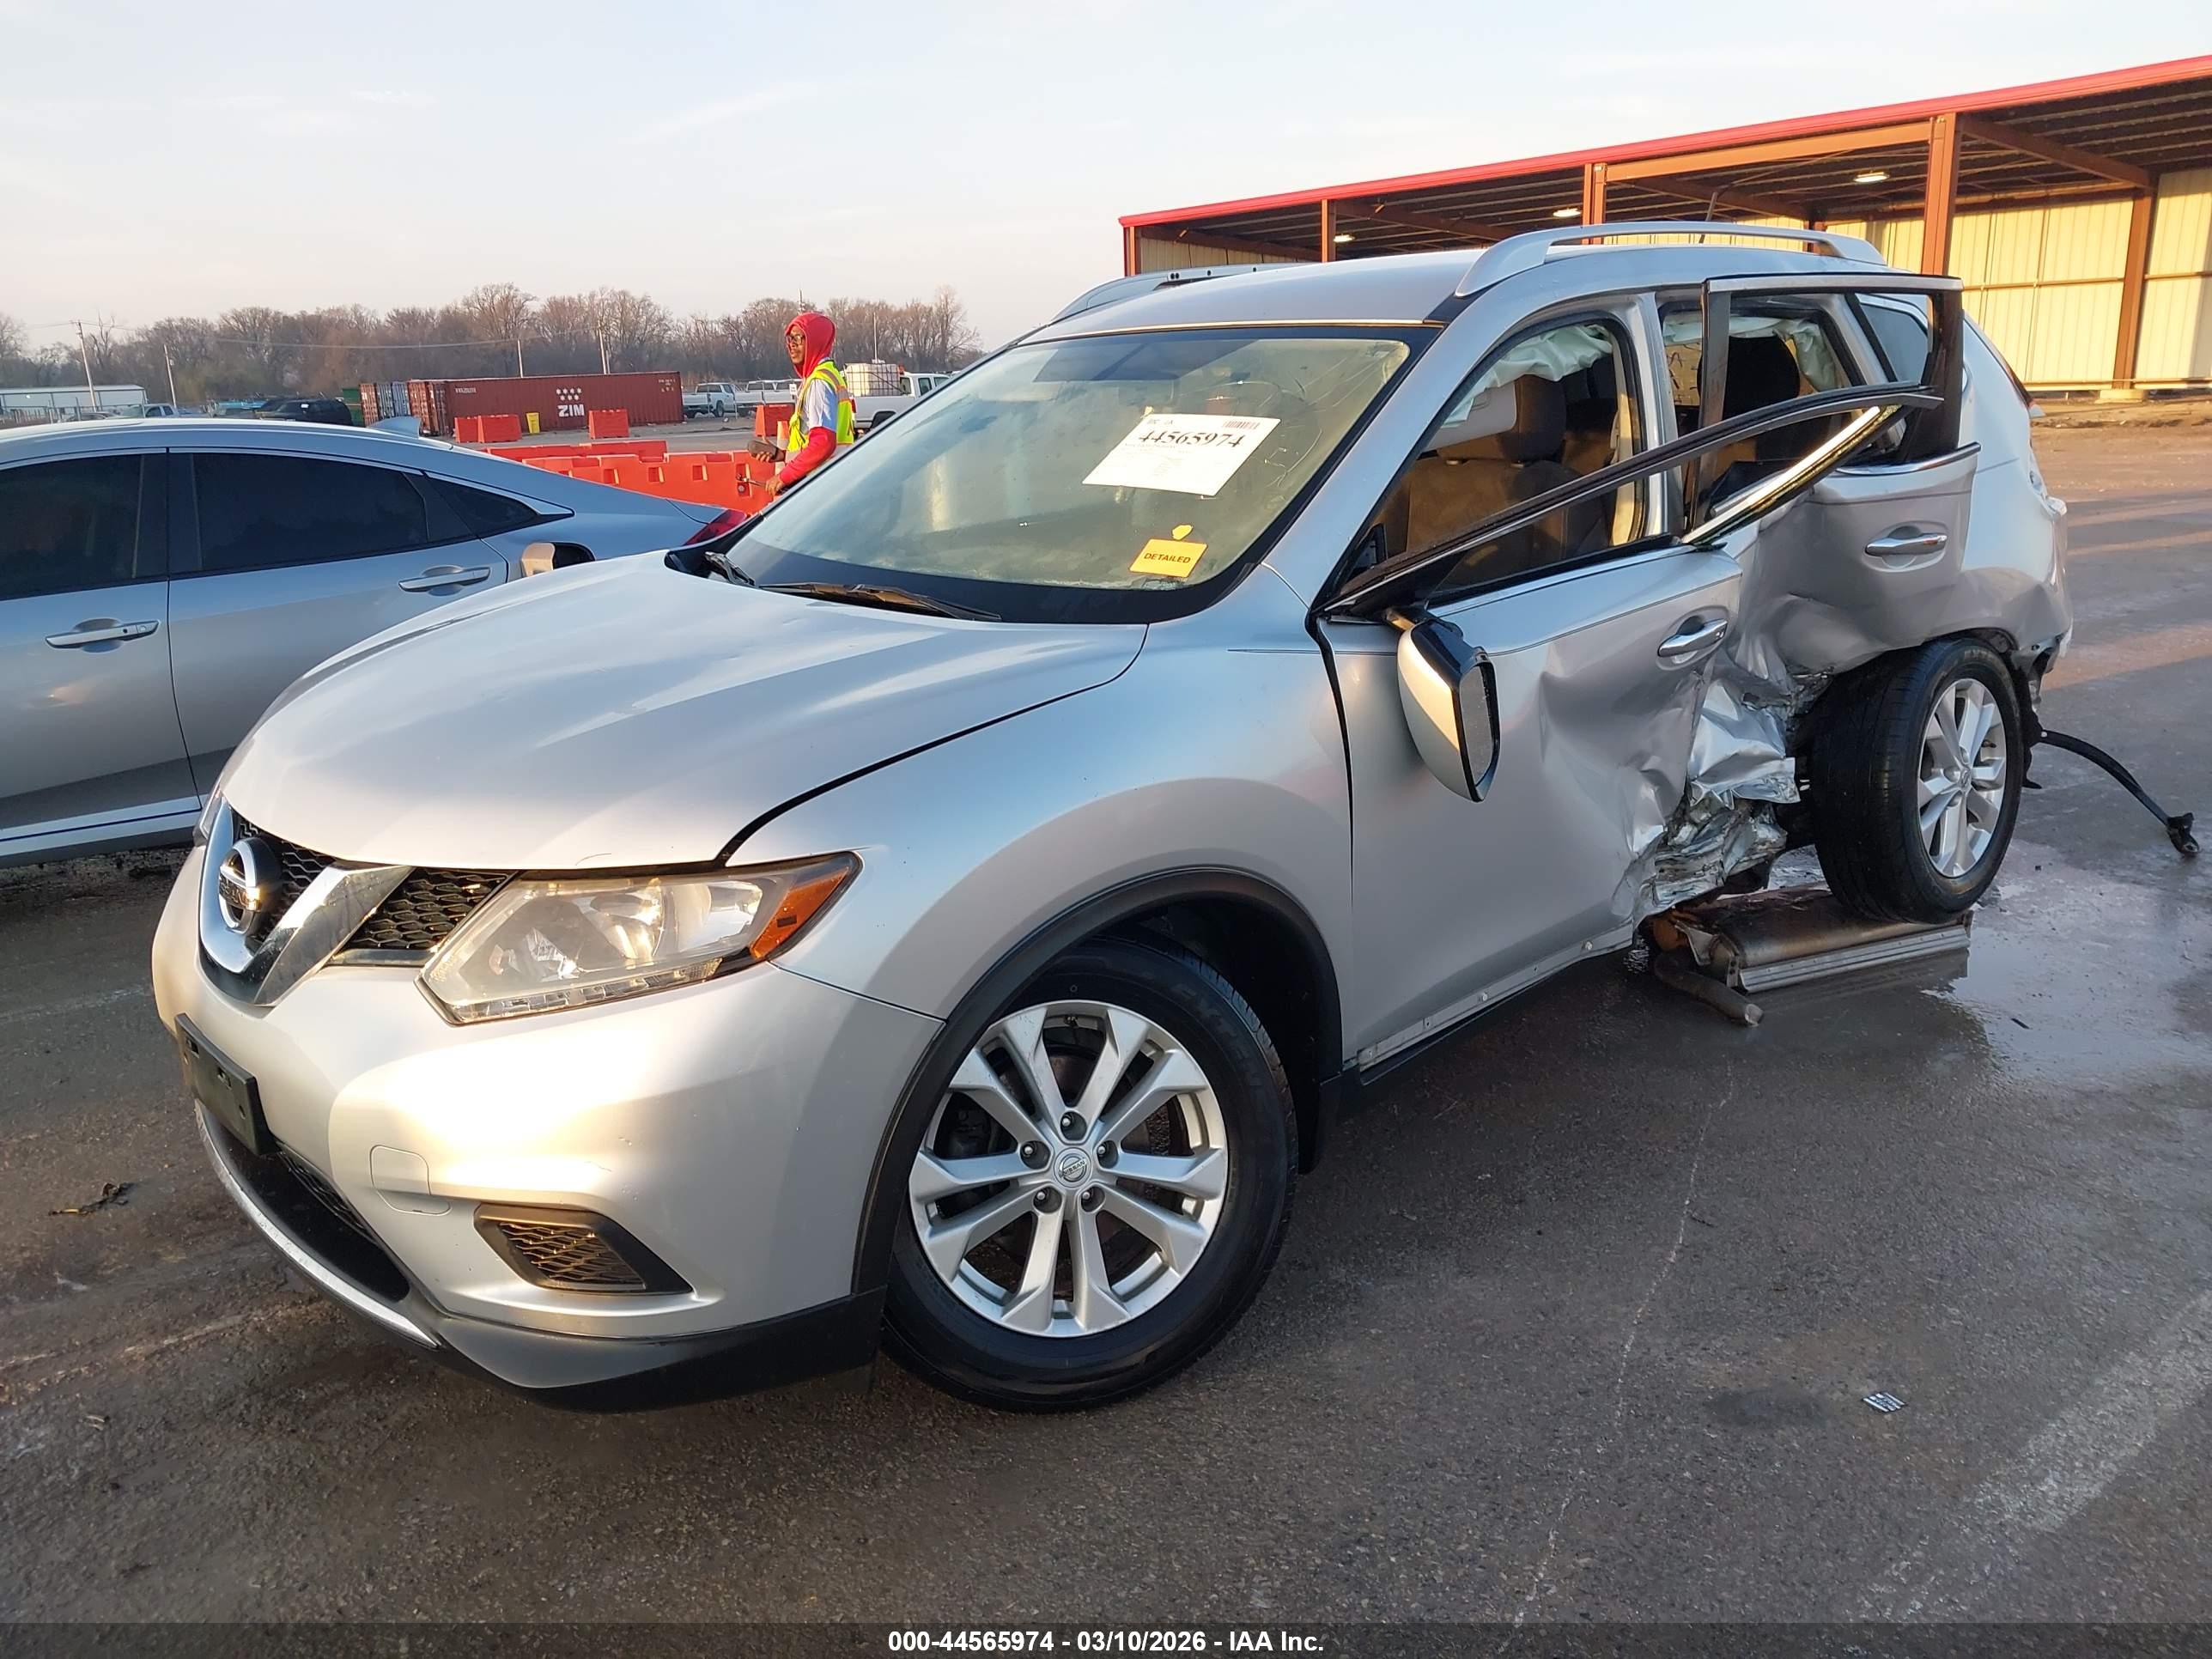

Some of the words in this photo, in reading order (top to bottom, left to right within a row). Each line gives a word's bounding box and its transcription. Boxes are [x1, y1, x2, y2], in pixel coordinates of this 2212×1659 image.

[557, 404, 585, 417] ZIM
[1139, 430, 1246, 447] 44565974
[1144, 552, 1191, 563] DETAILED
[1063, 1160, 1085, 1176] NISSAN
